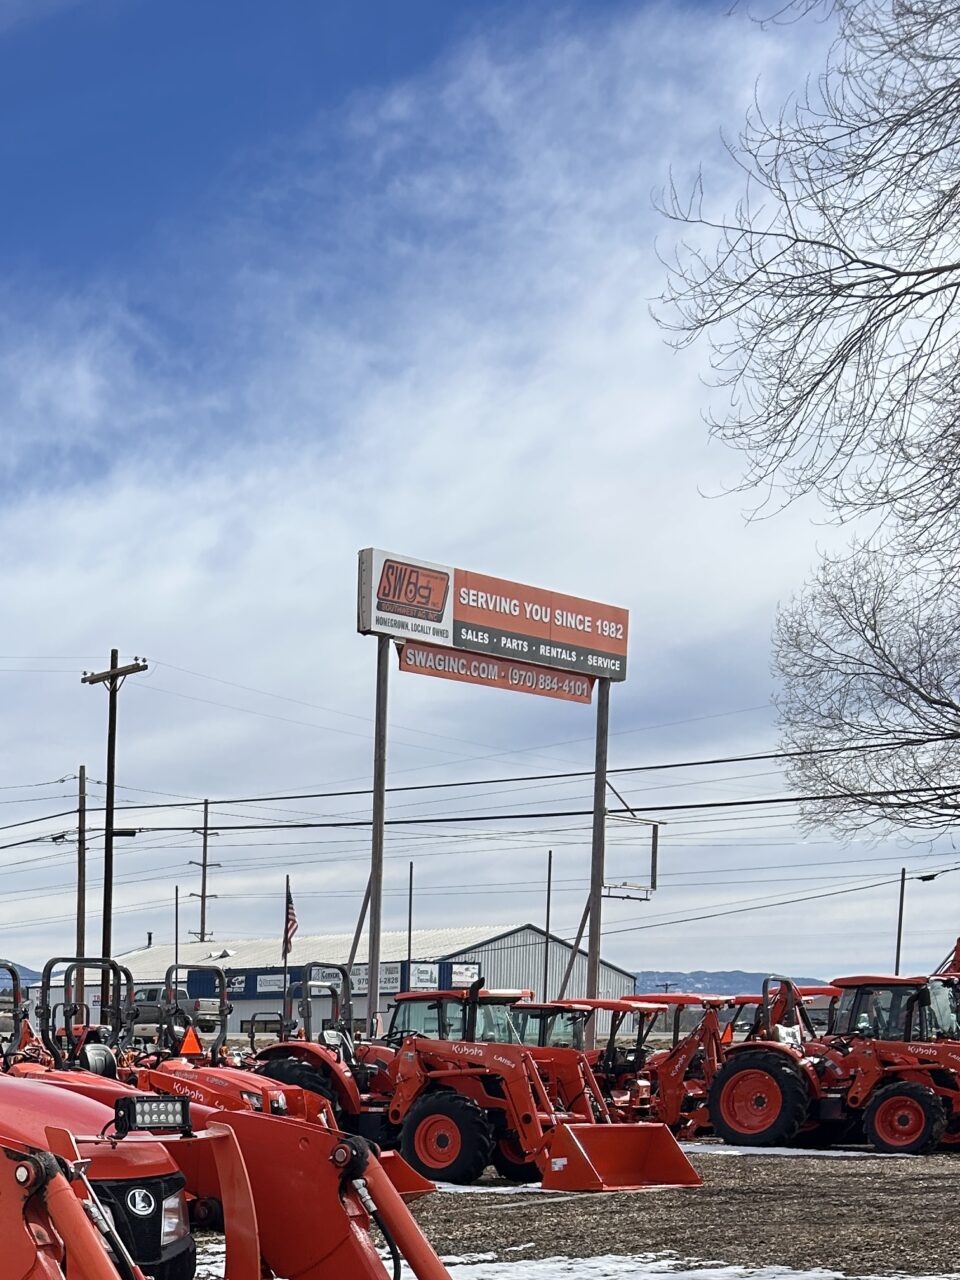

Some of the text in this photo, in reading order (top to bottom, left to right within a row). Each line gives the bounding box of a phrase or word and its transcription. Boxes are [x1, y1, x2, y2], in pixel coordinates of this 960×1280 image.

[459, 587, 624, 640] SERVING YOU SINCE 1982
[411, 622, 431, 635] LOCALLY
[432, 627, 449, 638] OWNED
[461, 628, 620, 671] SALES PARTS RENTALS SERVICE
[406, 648, 589, 697] SWAGINC.COM (970) 884-4101
[452, 1044, 483, 1056] Kubota
[908, 1045, 937, 1056] Kubota
[172, 1082, 204, 1102] Kubota
